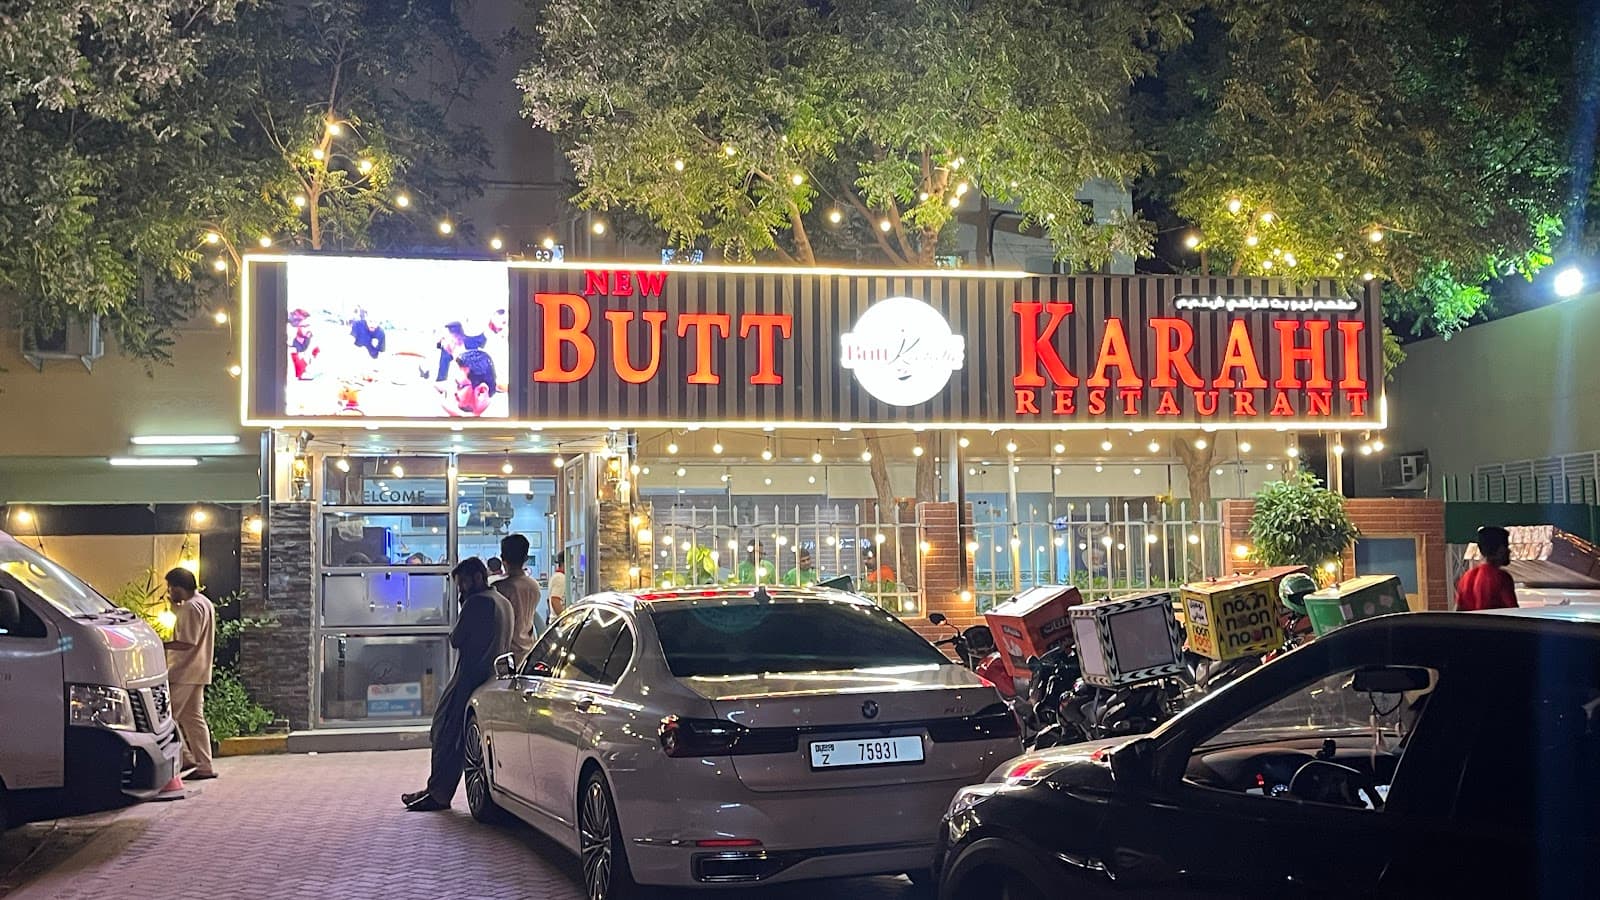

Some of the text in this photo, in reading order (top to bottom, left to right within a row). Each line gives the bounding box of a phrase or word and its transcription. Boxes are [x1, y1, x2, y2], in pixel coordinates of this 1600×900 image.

[584, 270, 669, 297] NEW
[533, 293, 793, 385] BUTT
[1012, 301, 1365, 389] KARAHI
[1014, 389, 1369, 416] RESTAURANT
[347, 490, 425, 503] WELCOME
[822, 754, 830, 765] Z
[858, 741, 898, 761] 75931
